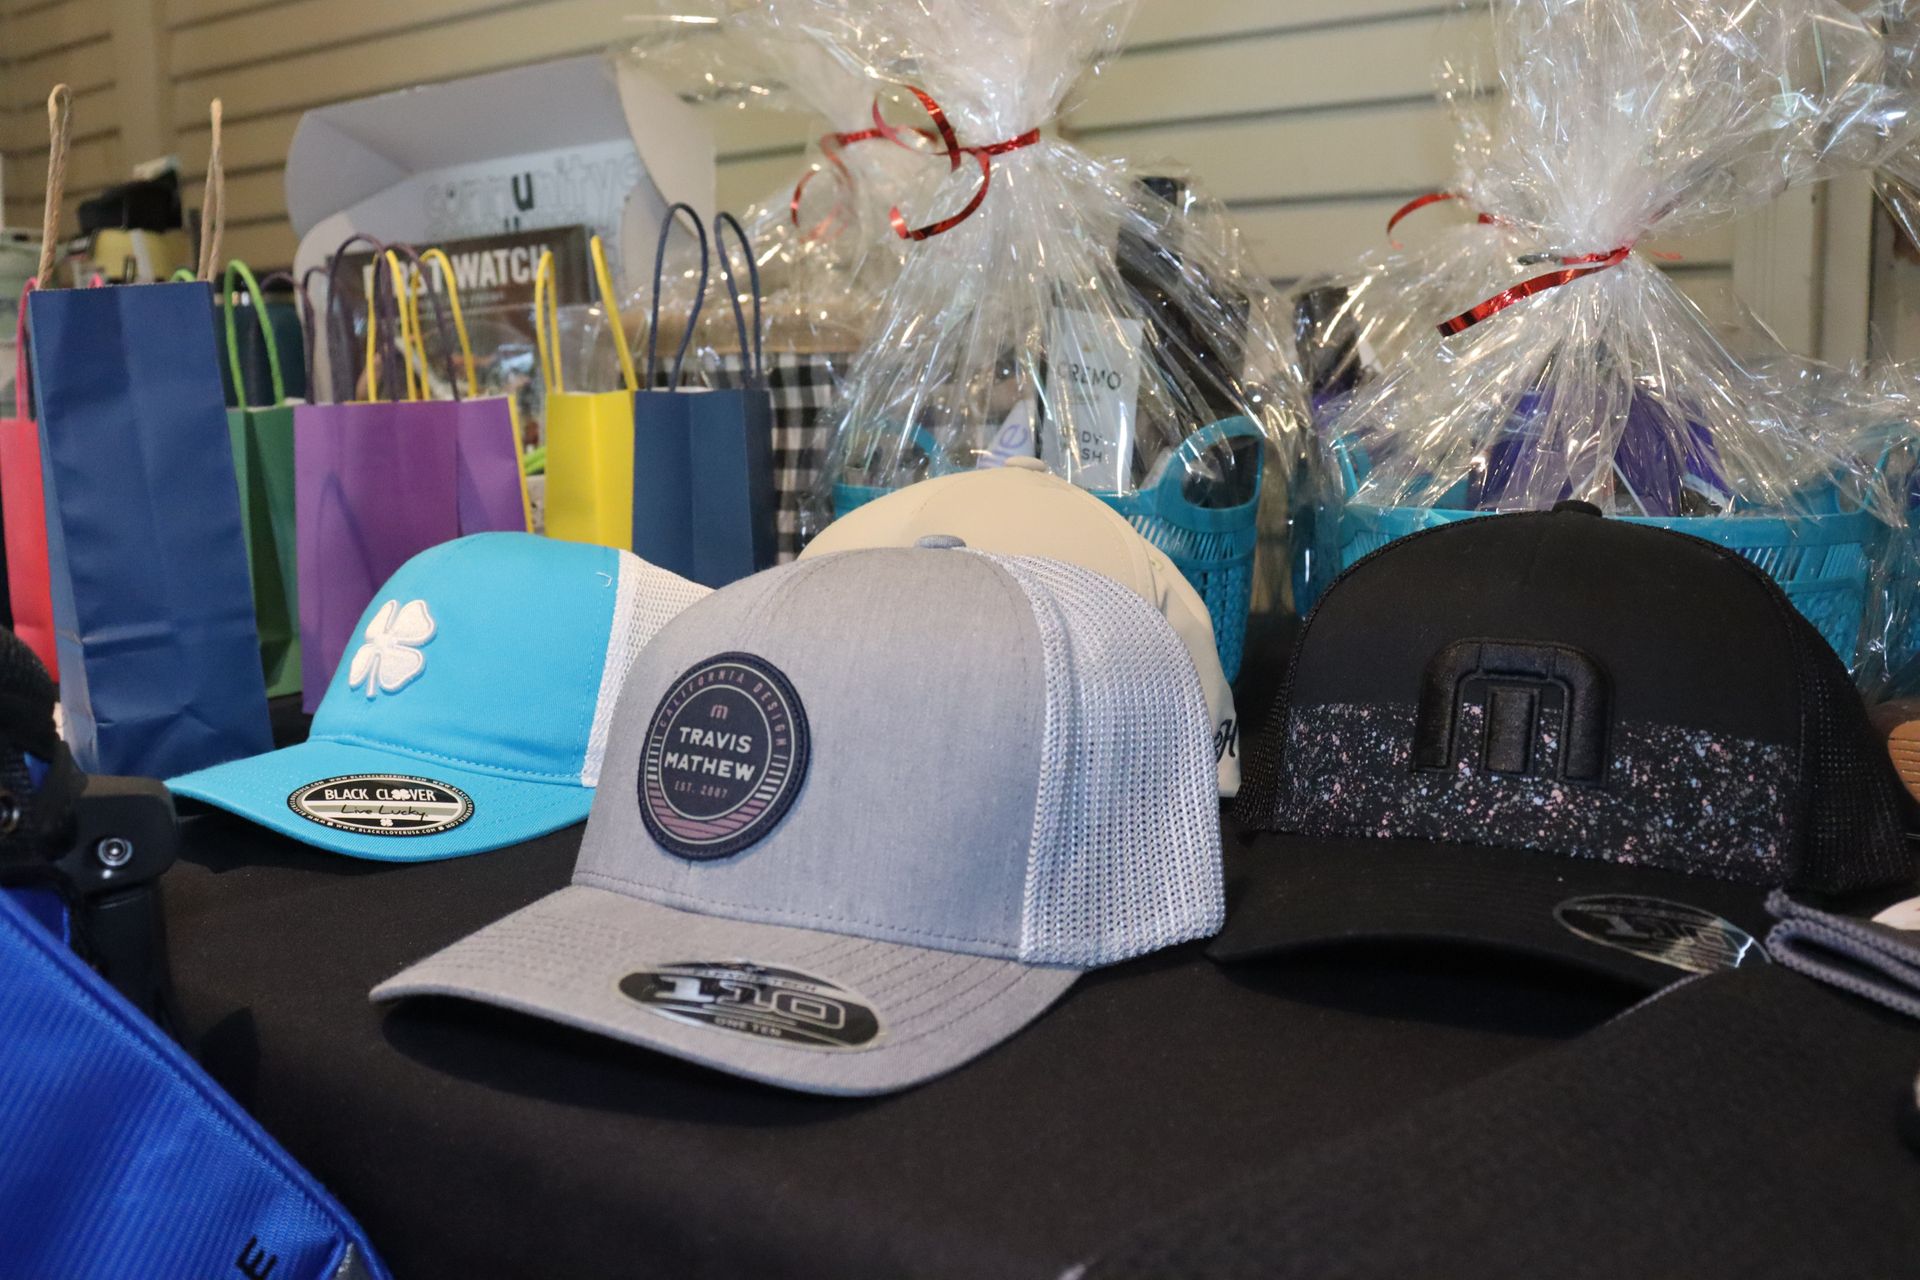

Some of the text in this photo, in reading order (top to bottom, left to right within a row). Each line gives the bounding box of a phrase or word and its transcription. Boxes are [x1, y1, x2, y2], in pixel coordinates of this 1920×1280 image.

[452, 245, 552, 288] WATCH
[679, 726, 753, 754] TRAVIS
[664, 751, 756, 782] MATHEW
[324, 788, 369, 800] BLACK
[341, 804, 373, 815] Live
